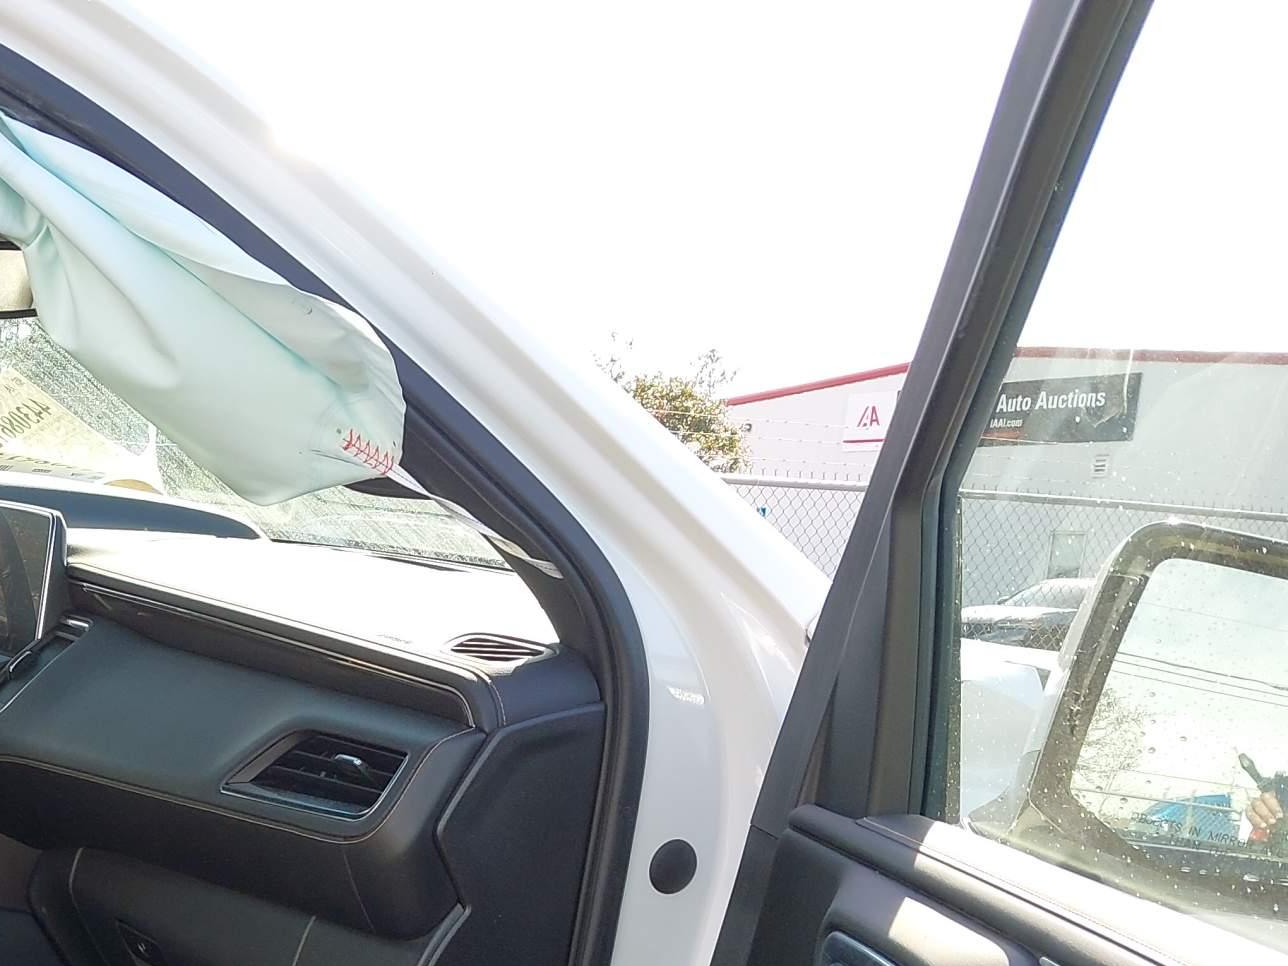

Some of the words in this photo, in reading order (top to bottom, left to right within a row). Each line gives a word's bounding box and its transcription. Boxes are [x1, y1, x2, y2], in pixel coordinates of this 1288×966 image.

[996, 394, 1032, 413] Auto
[1034, 390, 1106, 410] Auctions
[1188, 826, 1201, 837] IN
